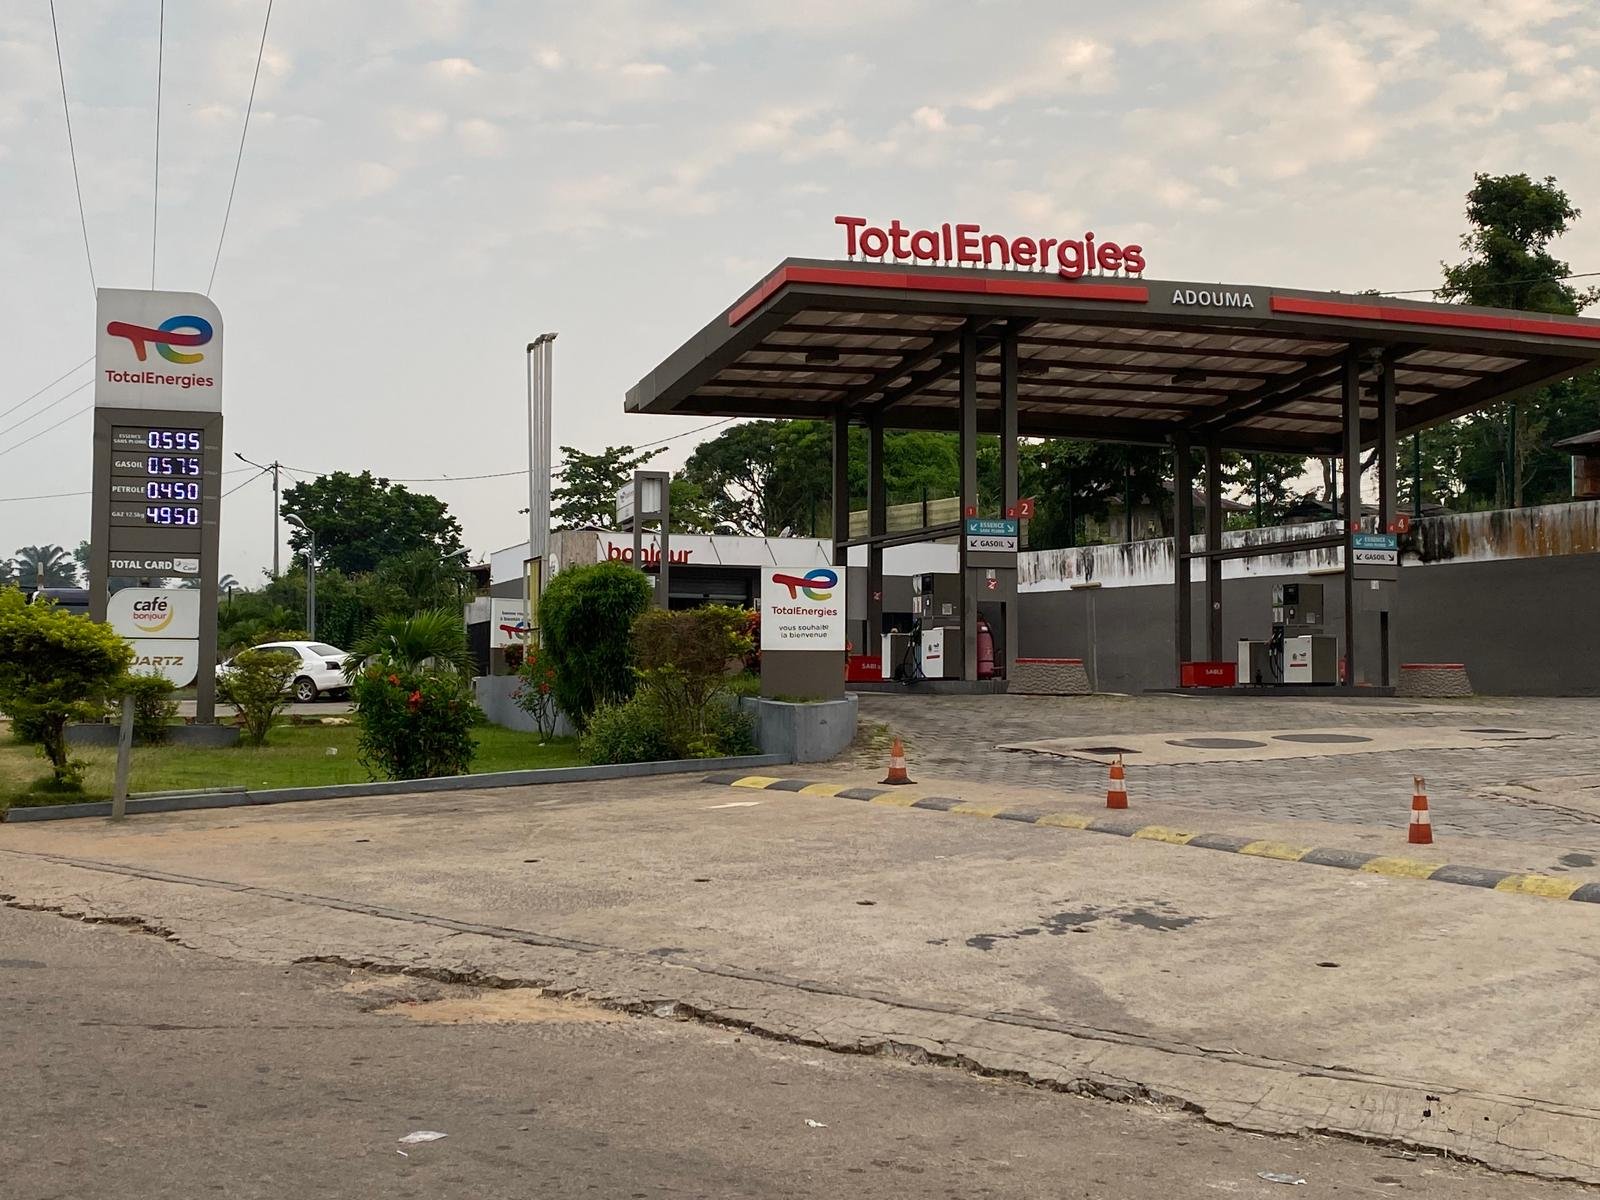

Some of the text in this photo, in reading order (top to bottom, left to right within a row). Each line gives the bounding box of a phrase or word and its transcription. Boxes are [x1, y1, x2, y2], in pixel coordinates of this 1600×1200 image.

[834, 215, 1146, 279] TotalEnergies
[1172, 289, 1254, 308] ADOUMA
[105, 370, 214, 388] TotalEnergies
[115, 460, 143, 469] GASOIL
[112, 485, 145, 494] PETROLE
[1021, 503, 1029, 515] 2
[1398, 518, 1405, 529] 4
[980, 540, 1004, 548] GASOIL
[110, 560, 172, 570] TOTAL CARD
[133, 597, 168, 611] café
[133, 612, 167, 622] bonjour
[771, 606, 838, 618] TotalEnergies
[129, 656, 184, 666] UARTZ
